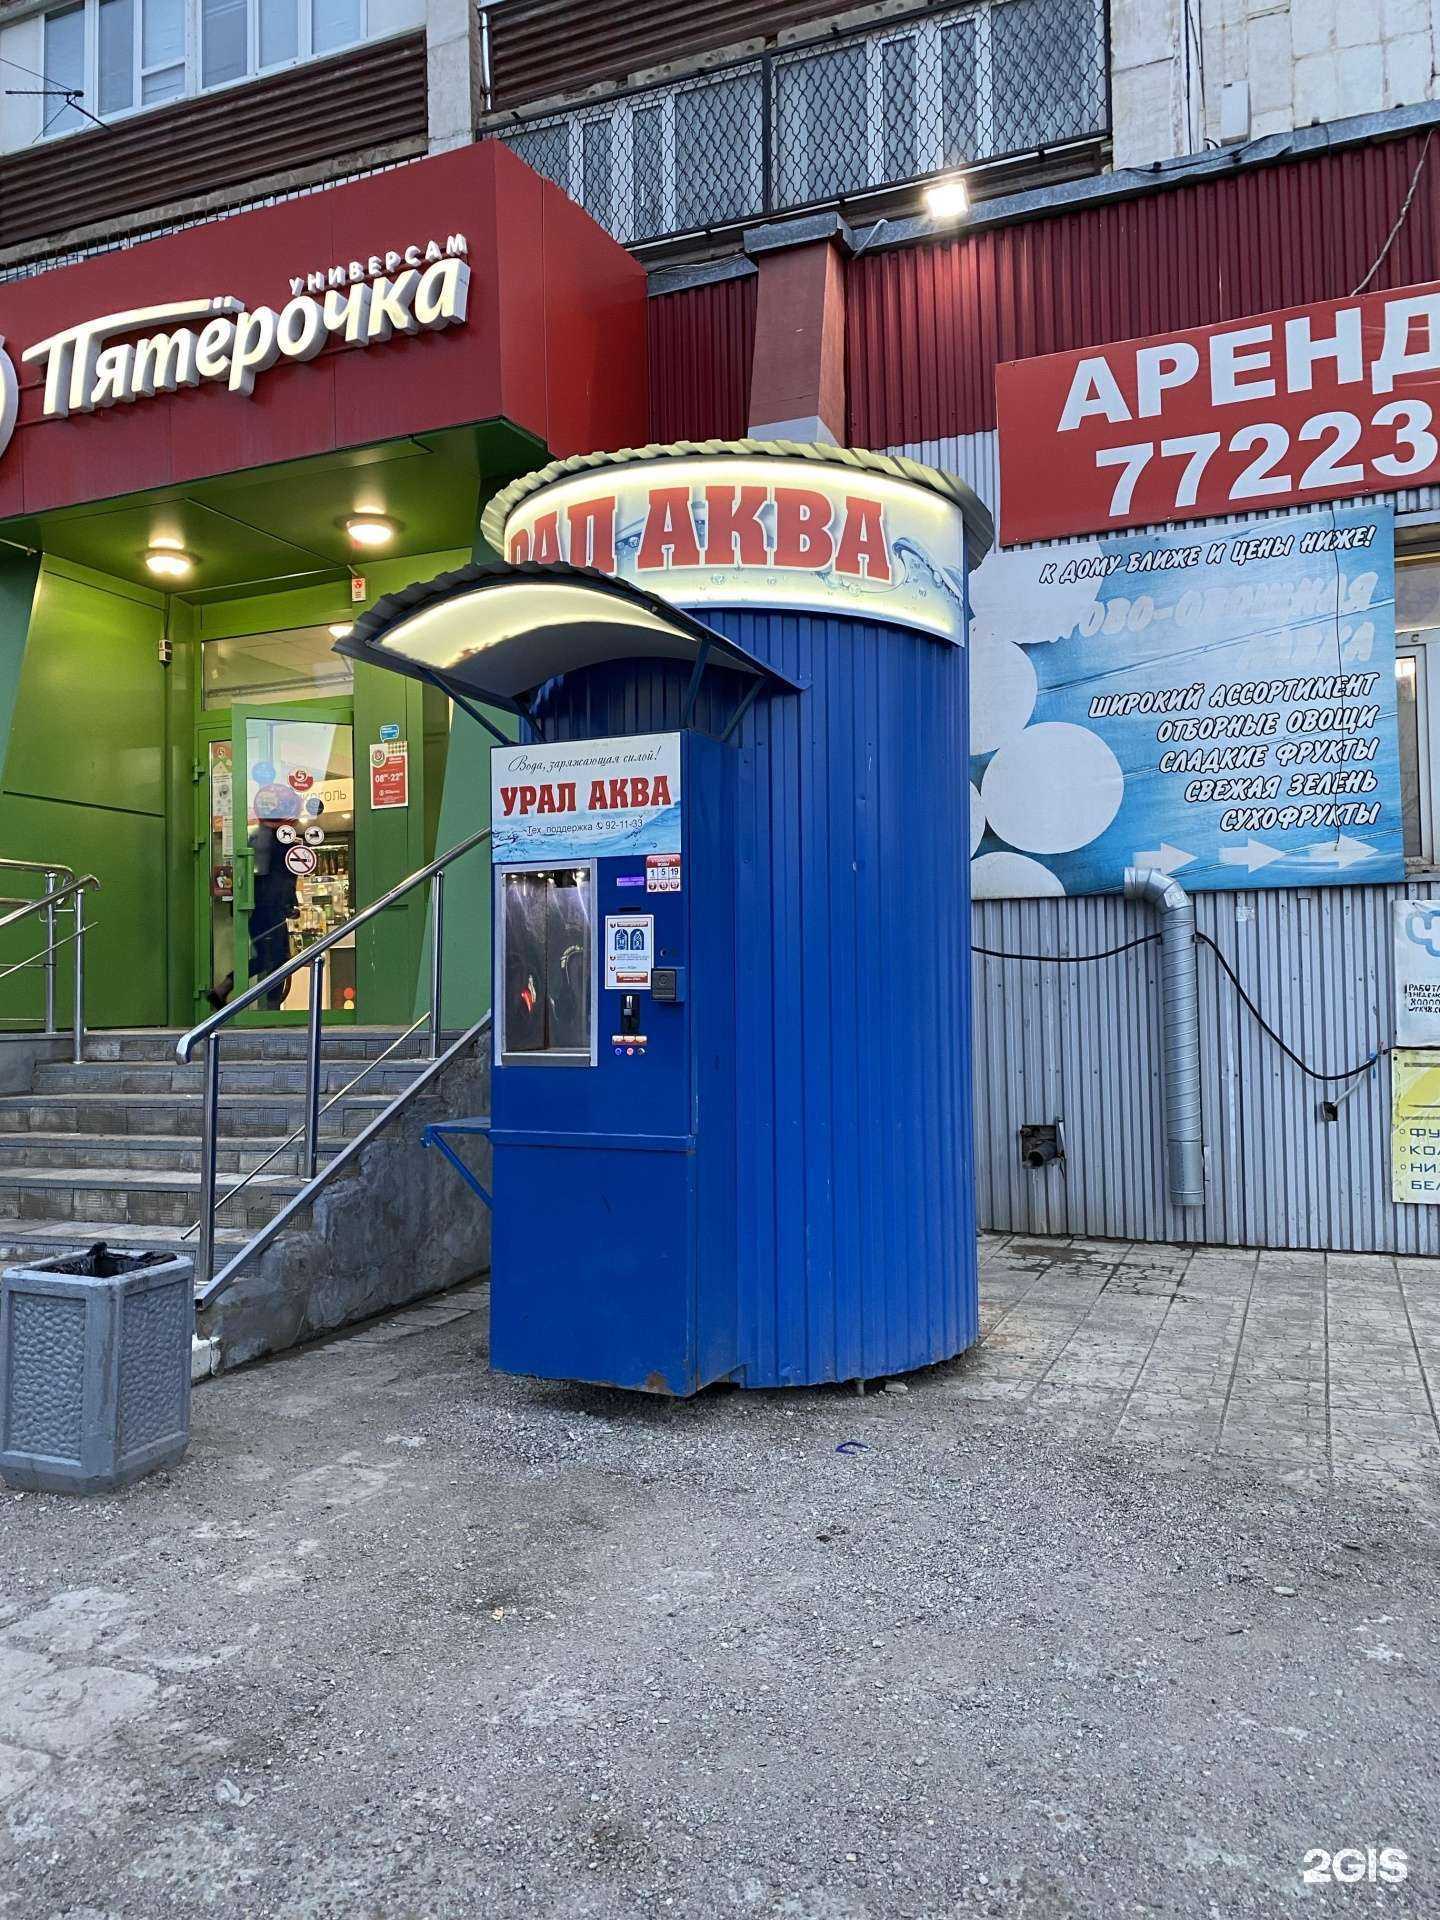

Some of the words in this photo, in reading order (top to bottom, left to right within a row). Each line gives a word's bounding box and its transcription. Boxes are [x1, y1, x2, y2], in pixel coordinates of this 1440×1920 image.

[289, 233, 468, 296] УНИВЕРСАМ
[1096, 400, 1440, 517] 77223
[636, 486, 890, 581] АКВА
[1039, 563, 1056, 584] К
[1059, 557, 1121, 585] ДОМУ
[1125, 546, 1202, 574] БЛИЖЕ
[1206, 542, 1227, 565] И
[1230, 536, 1295, 565] ЦЕНЫ
[1300, 525, 1377, 554] НИЖЕ!
[1088, 682, 1205, 718] ШИРОКИЙ
[1209, 672, 1380, 708] АССОРТИМЕНТ
[1157, 712, 1280, 743] ОТБОРНЫЕ
[1286, 704, 1380, 734] ОВОЩИ
[508, 754, 546, 775] Вода,
[547, 753, 620, 774] заряжающая
[623, 745, 662, 763] силой!
[1159, 745, 1269, 774] СЛАДКИЕ
[1276, 737, 1380, 767] ФРУКТЫ
[500, 782, 577, 816] УРАЛ
[588, 775, 672, 810] АКВА
[1184, 775, 1282, 802] СВЕЖАЯ
[1287, 769, 1378, 797] ЗЕЛЕНЬ
[546, 823, 593, 834] поддержка
[605, 819, 643, 831] 92-11-33
[1220, 802, 1381, 832] СУХОФРУКТЫ
[1410, 1145, 1440, 1155] КО
